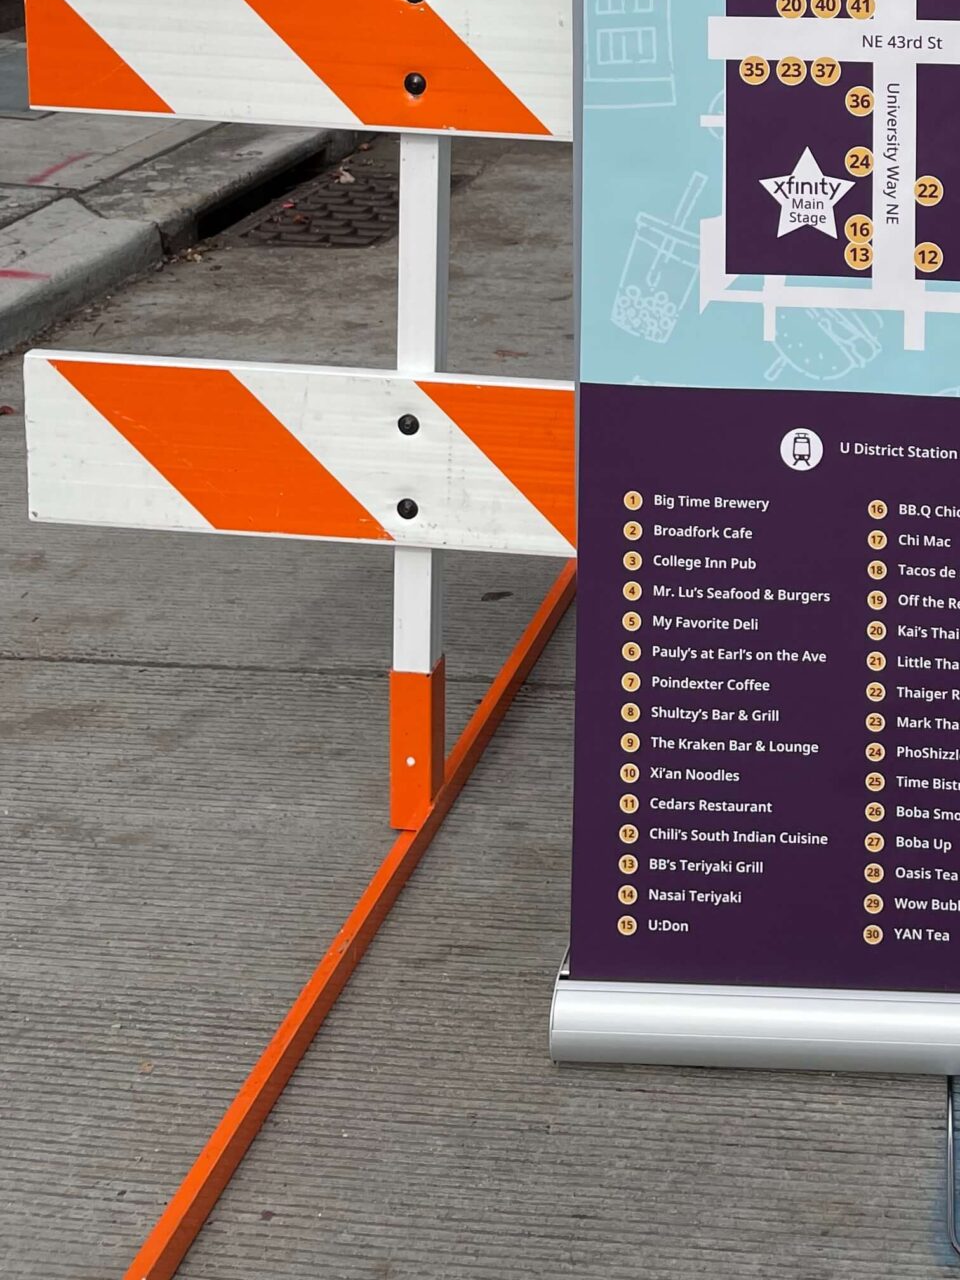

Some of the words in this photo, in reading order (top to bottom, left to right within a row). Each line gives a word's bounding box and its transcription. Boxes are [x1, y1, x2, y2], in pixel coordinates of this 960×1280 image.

[862, 34, 883, 48] NE
[887, 35, 923, 49] 43rd
[927, 36, 943, 50] St
[849, 93, 871, 109] 36
[882, 83, 901, 162] University
[773, 175, 842, 201] xfinity
[882, 165, 900, 199] Way
[791, 198, 825, 210] Main
[789, 211, 827, 226] Stage
[886, 203, 899, 225] NE
[840, 441, 850, 454] U
[854, 442, 905, 457] District
[907, 445, 958, 460] Station
[654, 494, 675, 510] Big
[677, 495, 711, 508] Time
[714, 496, 770, 513] Brewery
[898, 503, 932, 519] BB.Q
[897, 655, 932, 669] Little
[651, 675, 725, 690] Poindexter
[726, 678, 770, 691] Coffee
[649, 827, 688, 841] Chili's
[690, 829, 730, 842] South
[732, 830, 776, 843] Indian
[779, 831, 829, 845] Cuisine
[893, 928, 923, 941] YAN
[925, 928, 950, 942] Tea
